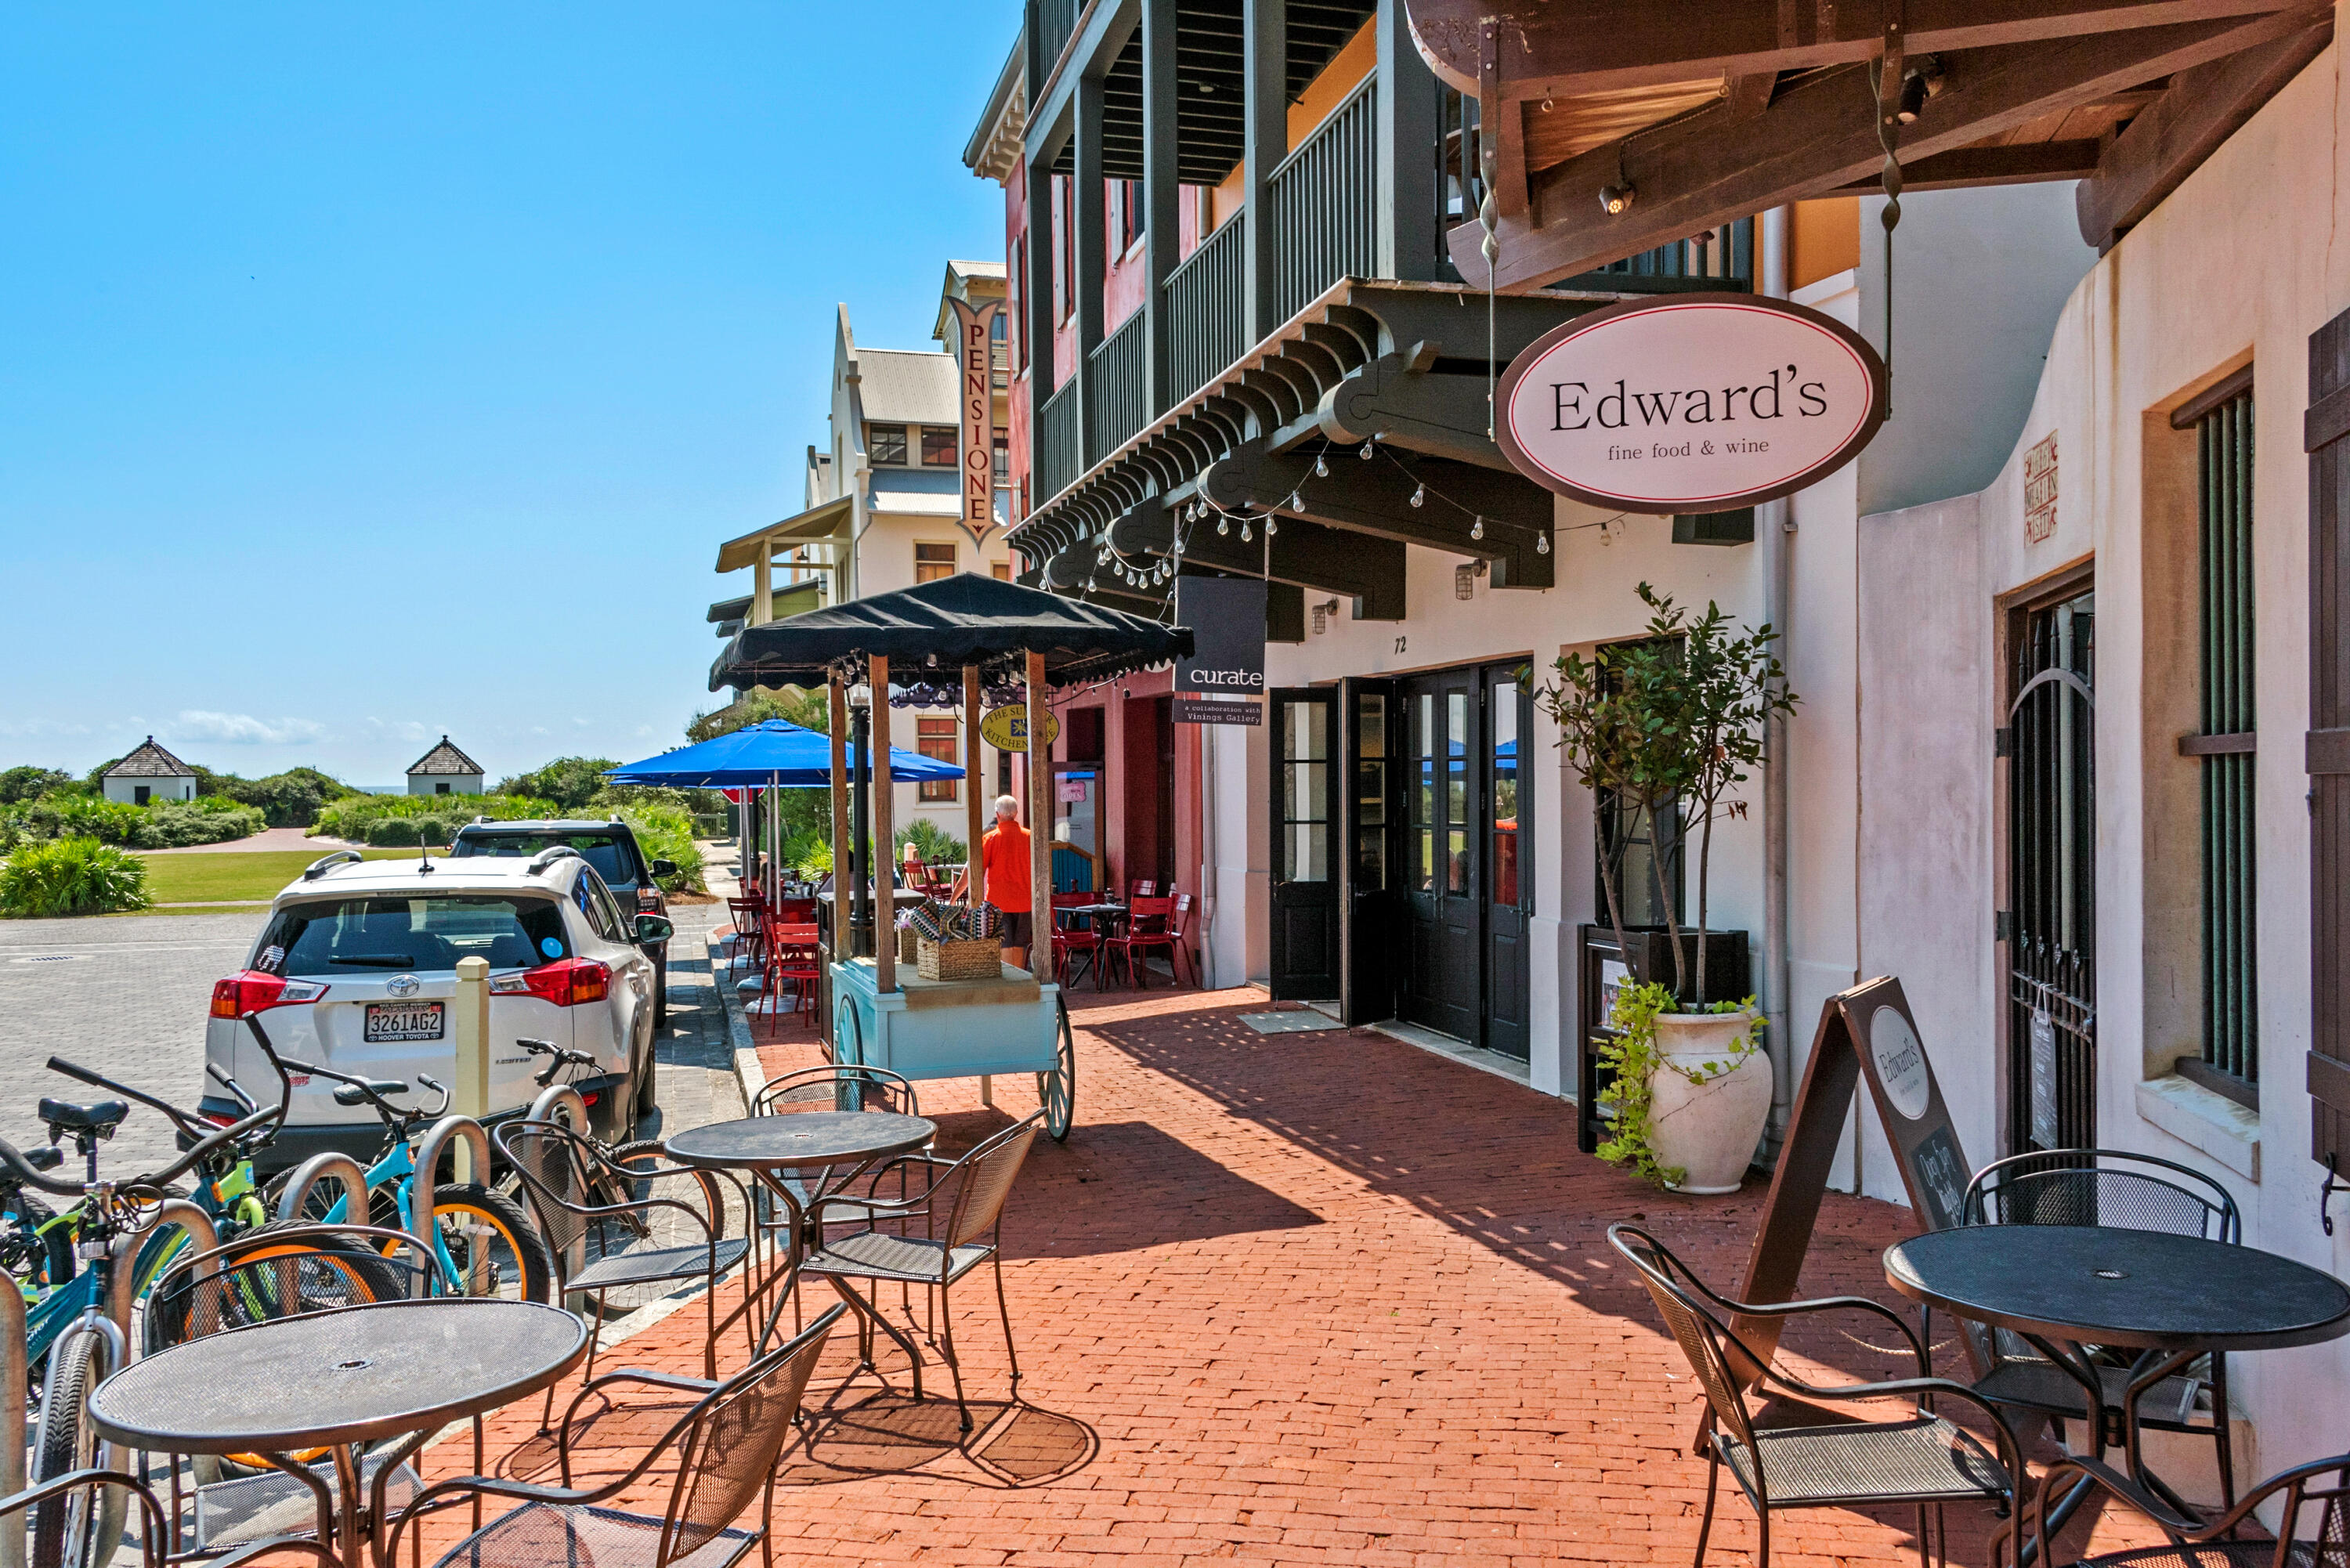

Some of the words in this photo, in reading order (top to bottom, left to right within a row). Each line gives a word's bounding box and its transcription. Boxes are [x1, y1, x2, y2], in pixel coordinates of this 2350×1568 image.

[1549, 363, 1828, 432] Edward's
[967, 324, 989, 520] PENSIONE
[1607, 445, 1643, 461] fine
[1652, 442, 1691, 459] food
[1701, 440, 1715, 456] &
[1726, 438, 1770, 454] wine
[1394, 635, 1407, 656] 72
[1190, 668, 1264, 686] curate
[986, 710, 1009, 724] THE
[1188, 714, 1222, 722] Vinings
[1226, 714, 1260, 724] Gallery
[985, 728, 1029, 749] KITCHEN
[371, 1013, 439, 1033] 3261AG2
[1878, 1037, 1919, 1083] Edward's
